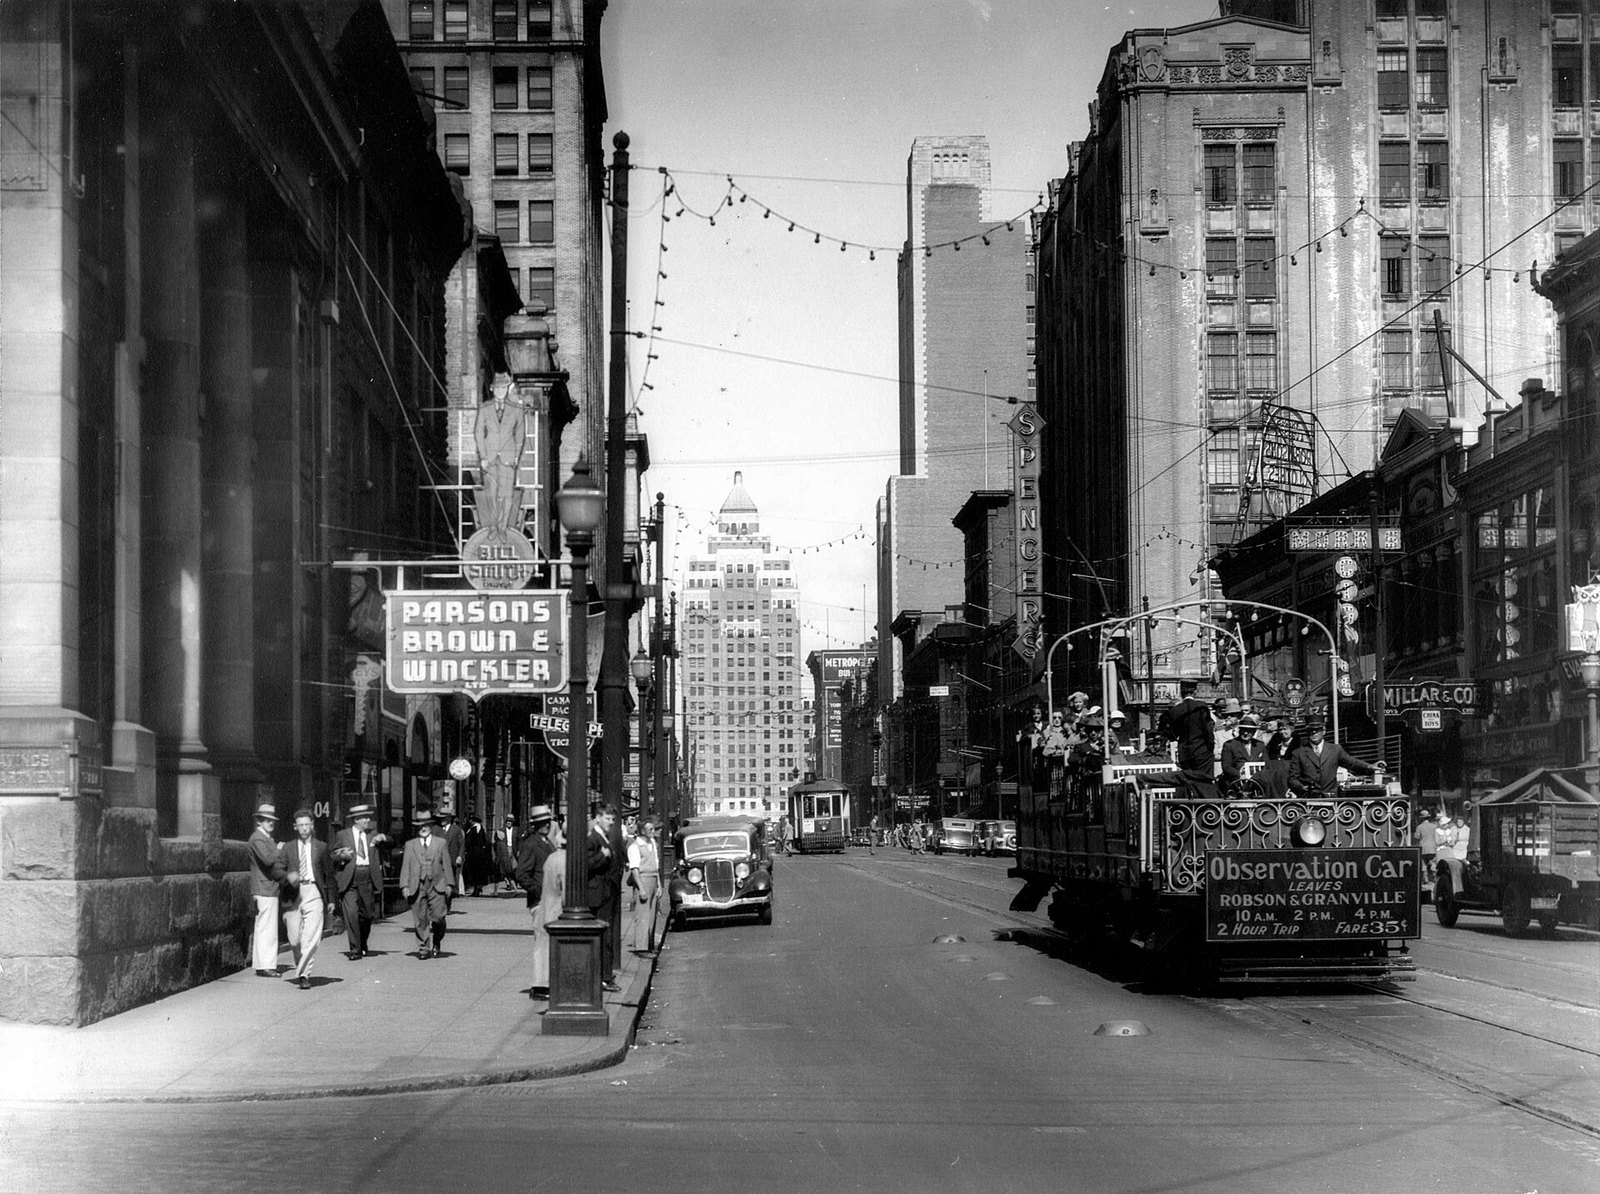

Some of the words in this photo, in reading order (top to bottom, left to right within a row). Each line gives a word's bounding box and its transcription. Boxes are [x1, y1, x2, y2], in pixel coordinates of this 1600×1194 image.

[480, 544, 520, 559] BILL
[402, 600, 550, 623] PARSONS
[402, 630, 517, 652] BROWN
[402, 659, 550, 682] WINCKLER
[1562, 659, 1582, 678] EVA
[1384, 687, 1441, 707] MILLAR
[1442, 690, 1453, 703] &
[1210, 856, 1358, 881] Observation
[1365, 854, 1413, 879] Car
[1288, 881, 1343, 891] LEAVES
[1220, 894, 1287, 907] ROBSON
[1289, 894, 1301, 906] &
[1301, 891, 1406, 906] GRANVILLE
[1236, 910, 1251, 922] 10
[1254, 912, 1278, 921] A.M.
[1294, 909, 1304, 921] 2
[1309, 911, 1335, 921] P.M.
[1354, 908, 1366, 920] 4
[1369, 910, 1393, 919] P.M.
[1217, 923, 1229, 936] 2
[1231, 923, 1268, 936] HOUR
[1273, 922, 1300, 935] TRIP
